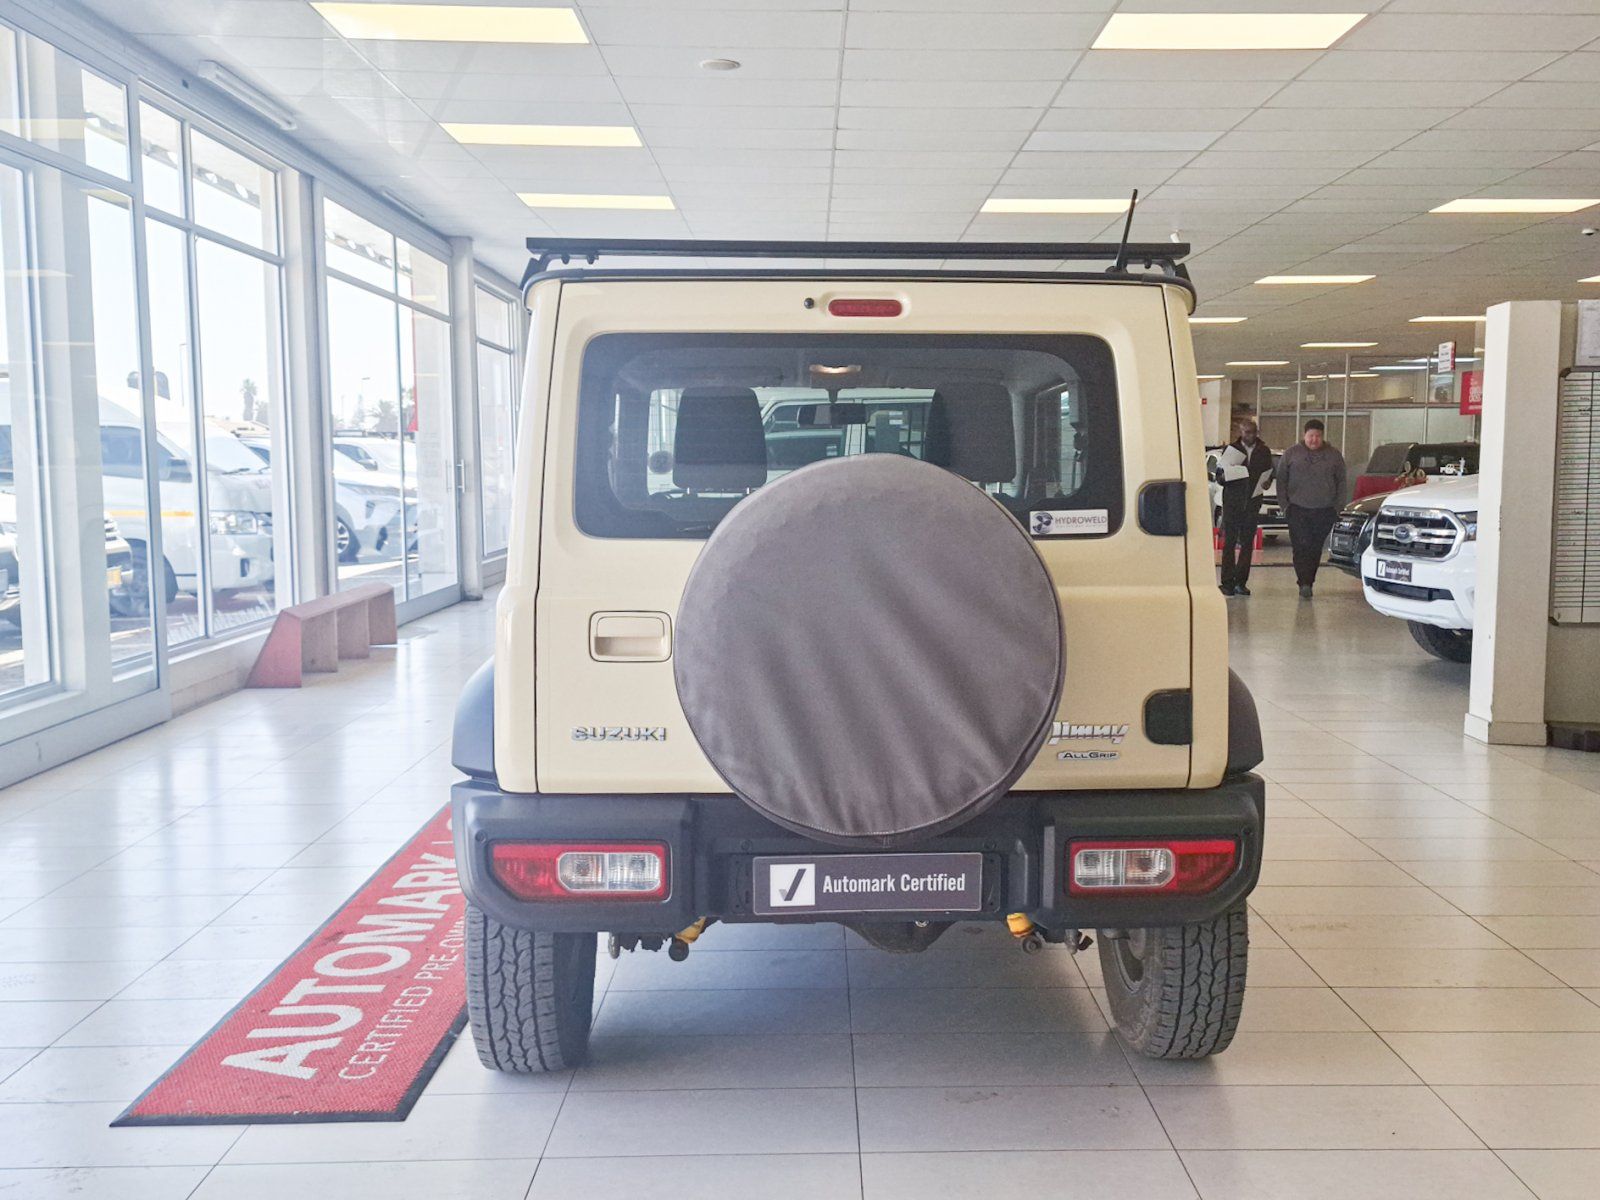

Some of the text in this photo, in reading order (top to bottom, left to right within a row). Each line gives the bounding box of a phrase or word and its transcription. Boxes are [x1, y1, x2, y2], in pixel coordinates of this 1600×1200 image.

[1055, 516, 1107, 525] HYDROWELD
[571, 726, 666, 741] SUZUKI
[1048, 721, 1129, 746] Jimny
[822, 873, 966, 893] Automark Certified
[220, 852, 462, 1081] AUTOMARK
[338, 985, 434, 1081] CERTIFIED
